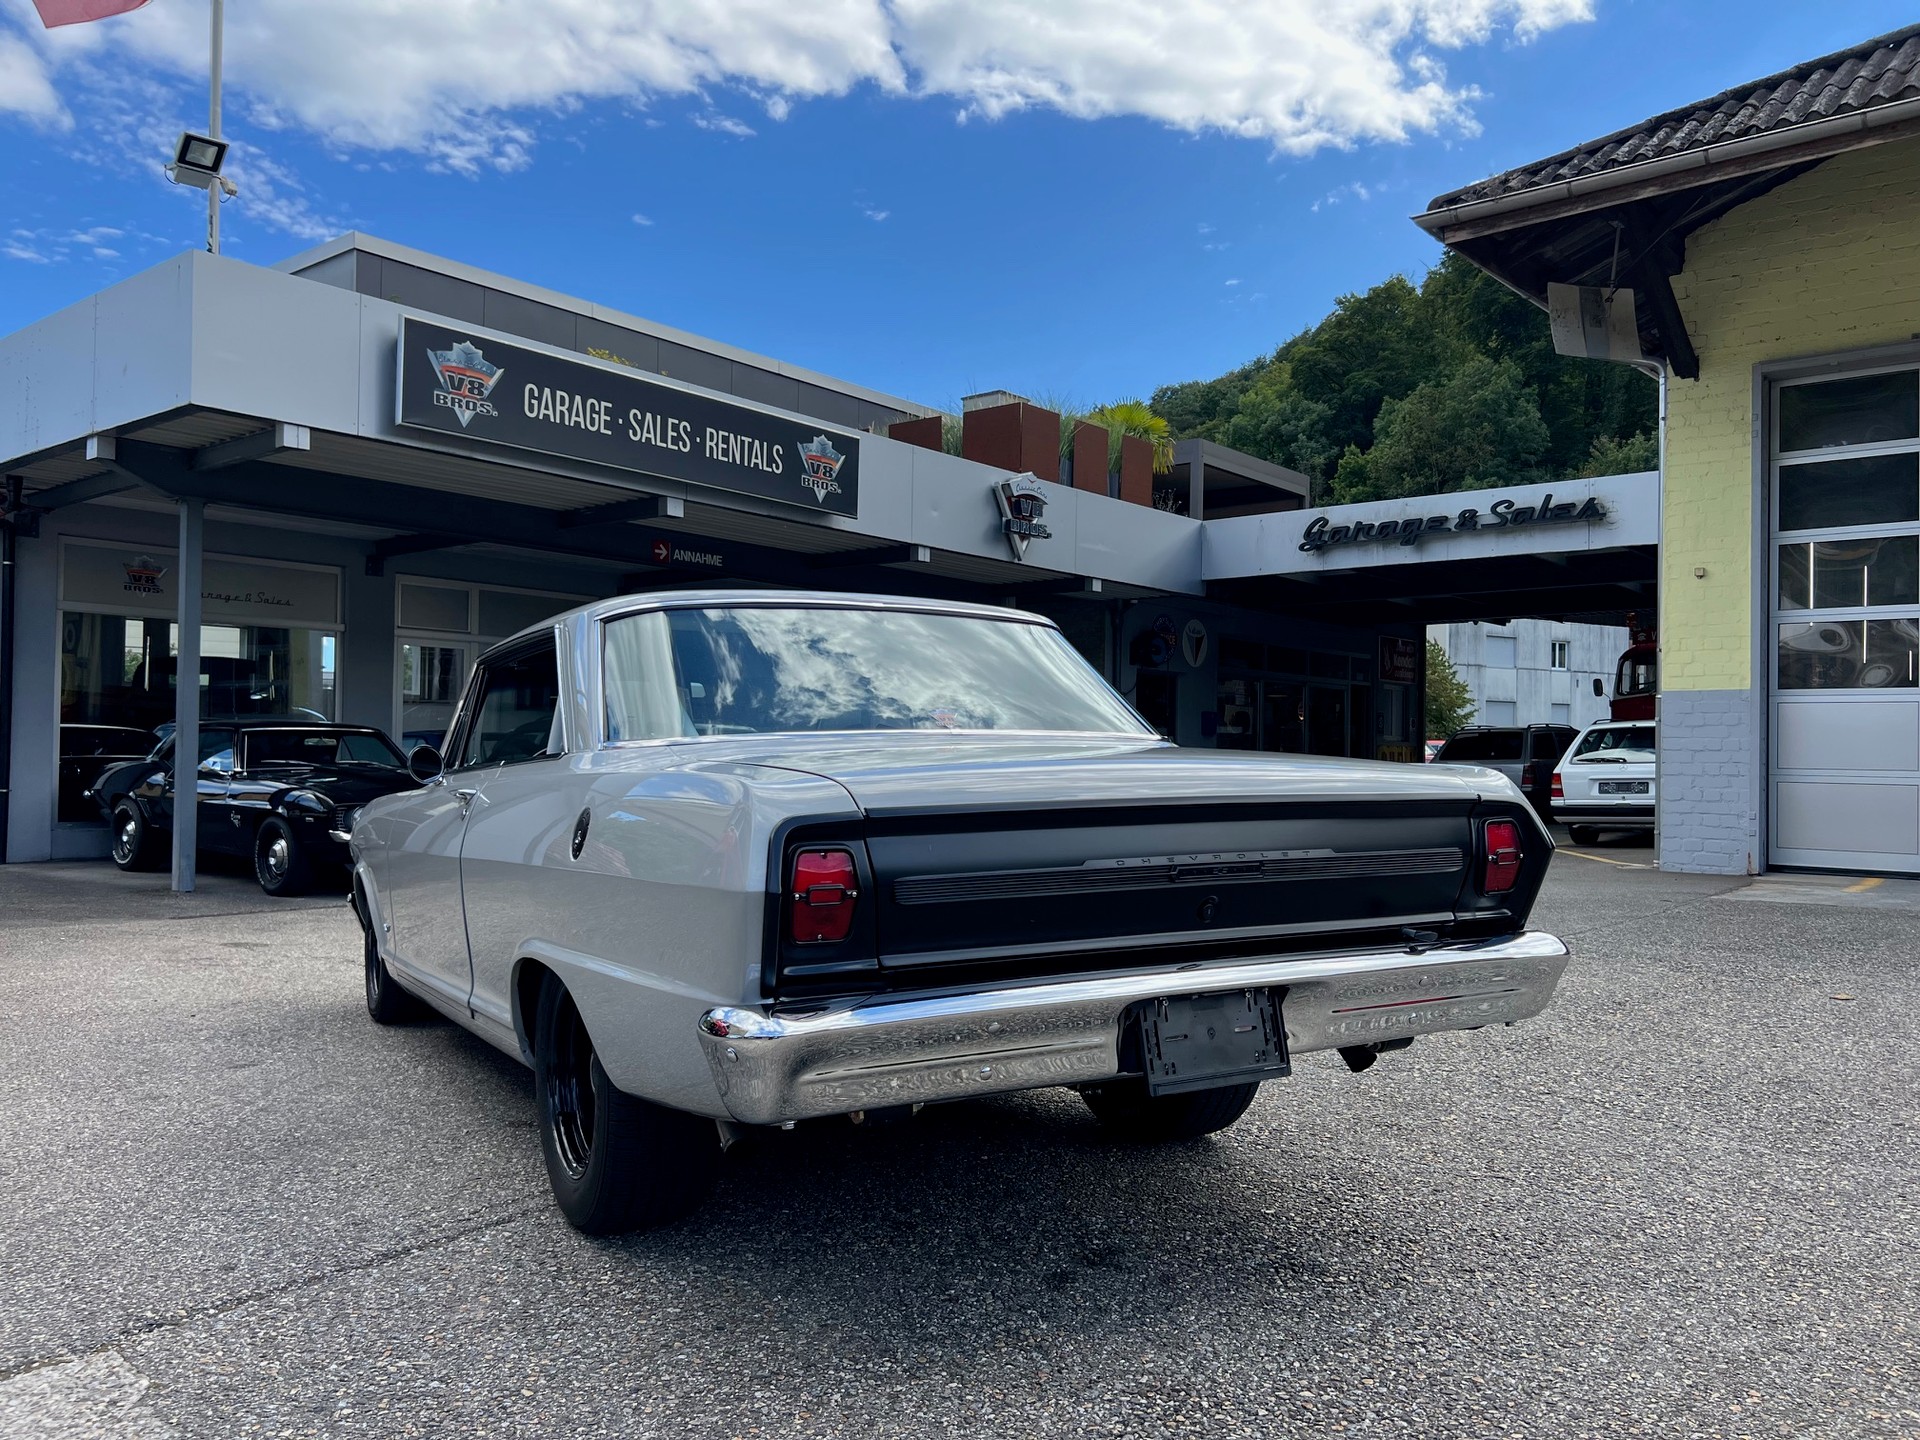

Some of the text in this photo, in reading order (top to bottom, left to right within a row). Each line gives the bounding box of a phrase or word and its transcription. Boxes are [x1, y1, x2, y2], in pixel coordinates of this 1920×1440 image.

[445, 372, 485, 399] V8
[524, 383, 783, 474] GARAGE SALES RENTALS
[808, 461, 834, 480] V8
[1019, 498, 1043, 517] V8
[1298, 493, 1606, 553] Garage & Sales
[673, 548, 723, 567] ANNAHME
[132, 573, 157, 585] V8
[245, 593, 252, 602] &
[254, 592, 294, 607] Sales
[1115, 850, 1311, 863] CHEVROLET
